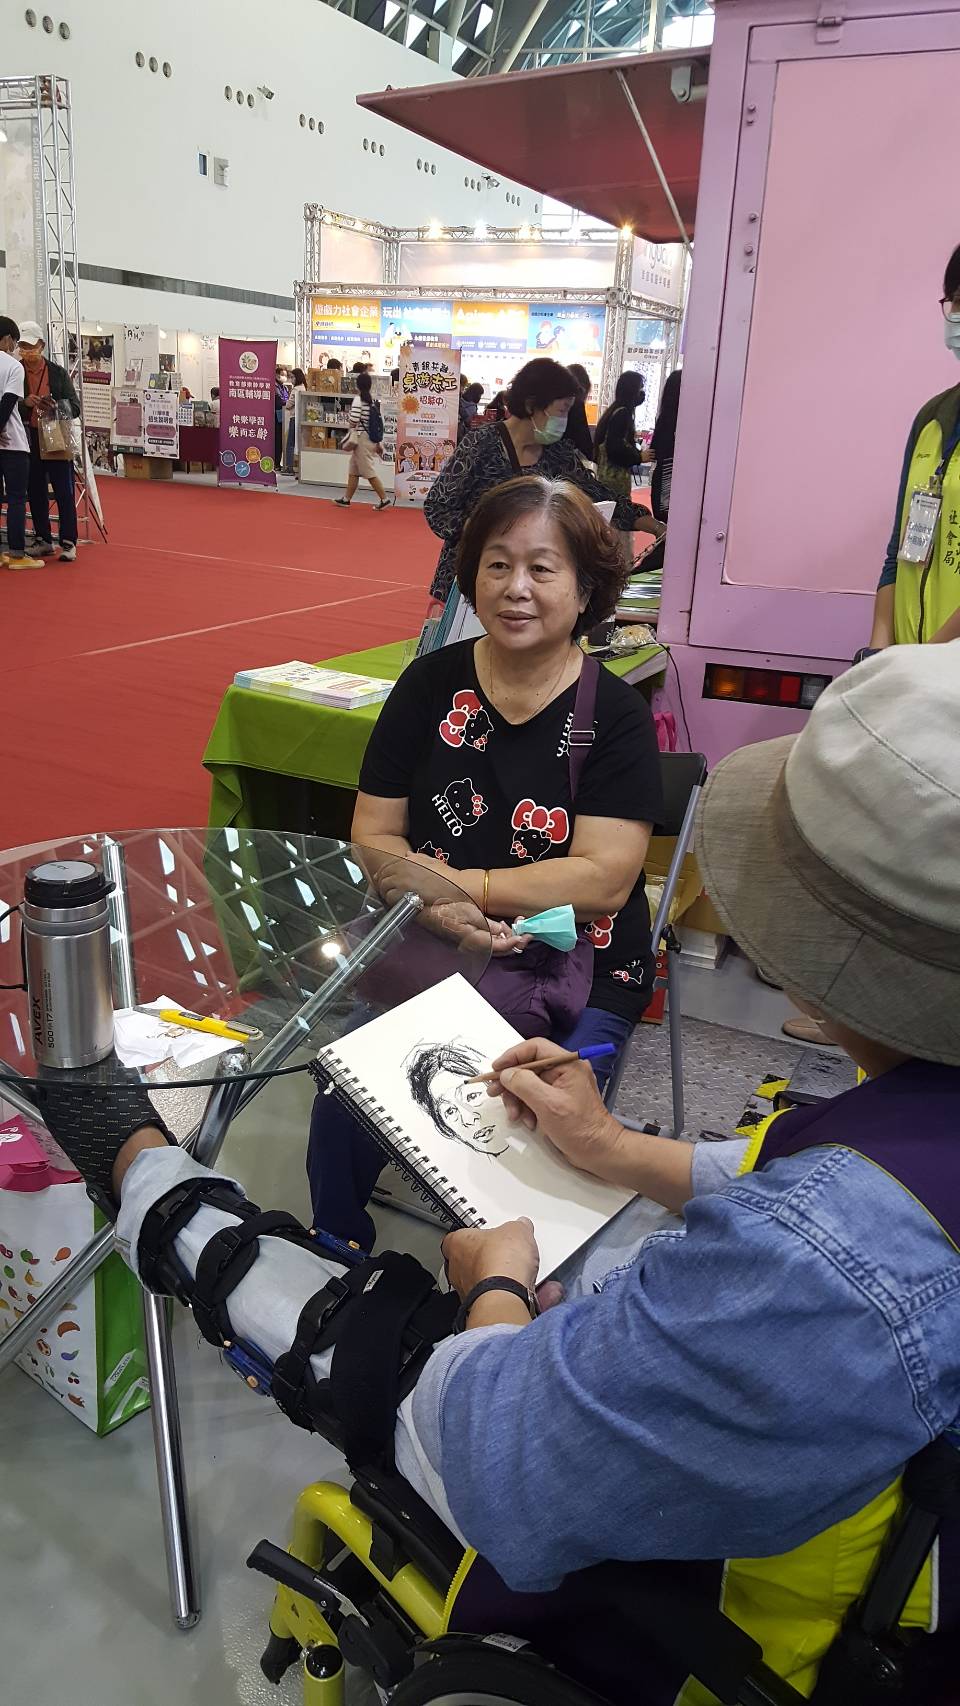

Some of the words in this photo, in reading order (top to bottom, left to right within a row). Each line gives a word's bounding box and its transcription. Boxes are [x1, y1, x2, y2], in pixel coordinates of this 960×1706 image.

[403, 371, 458, 394] 桌遊志工
[229, 388, 271, 400] 南區輔導團
[232, 414, 265, 426] 快樂學習
[228, 425, 268, 441] 樂而忘齡
[943, 509, 960, 567] 社會局
[431, 794, 463, 837] HELLO
[33, 996, 44, 1045] AVEX
[47, 1030, 55, 1049] 500
